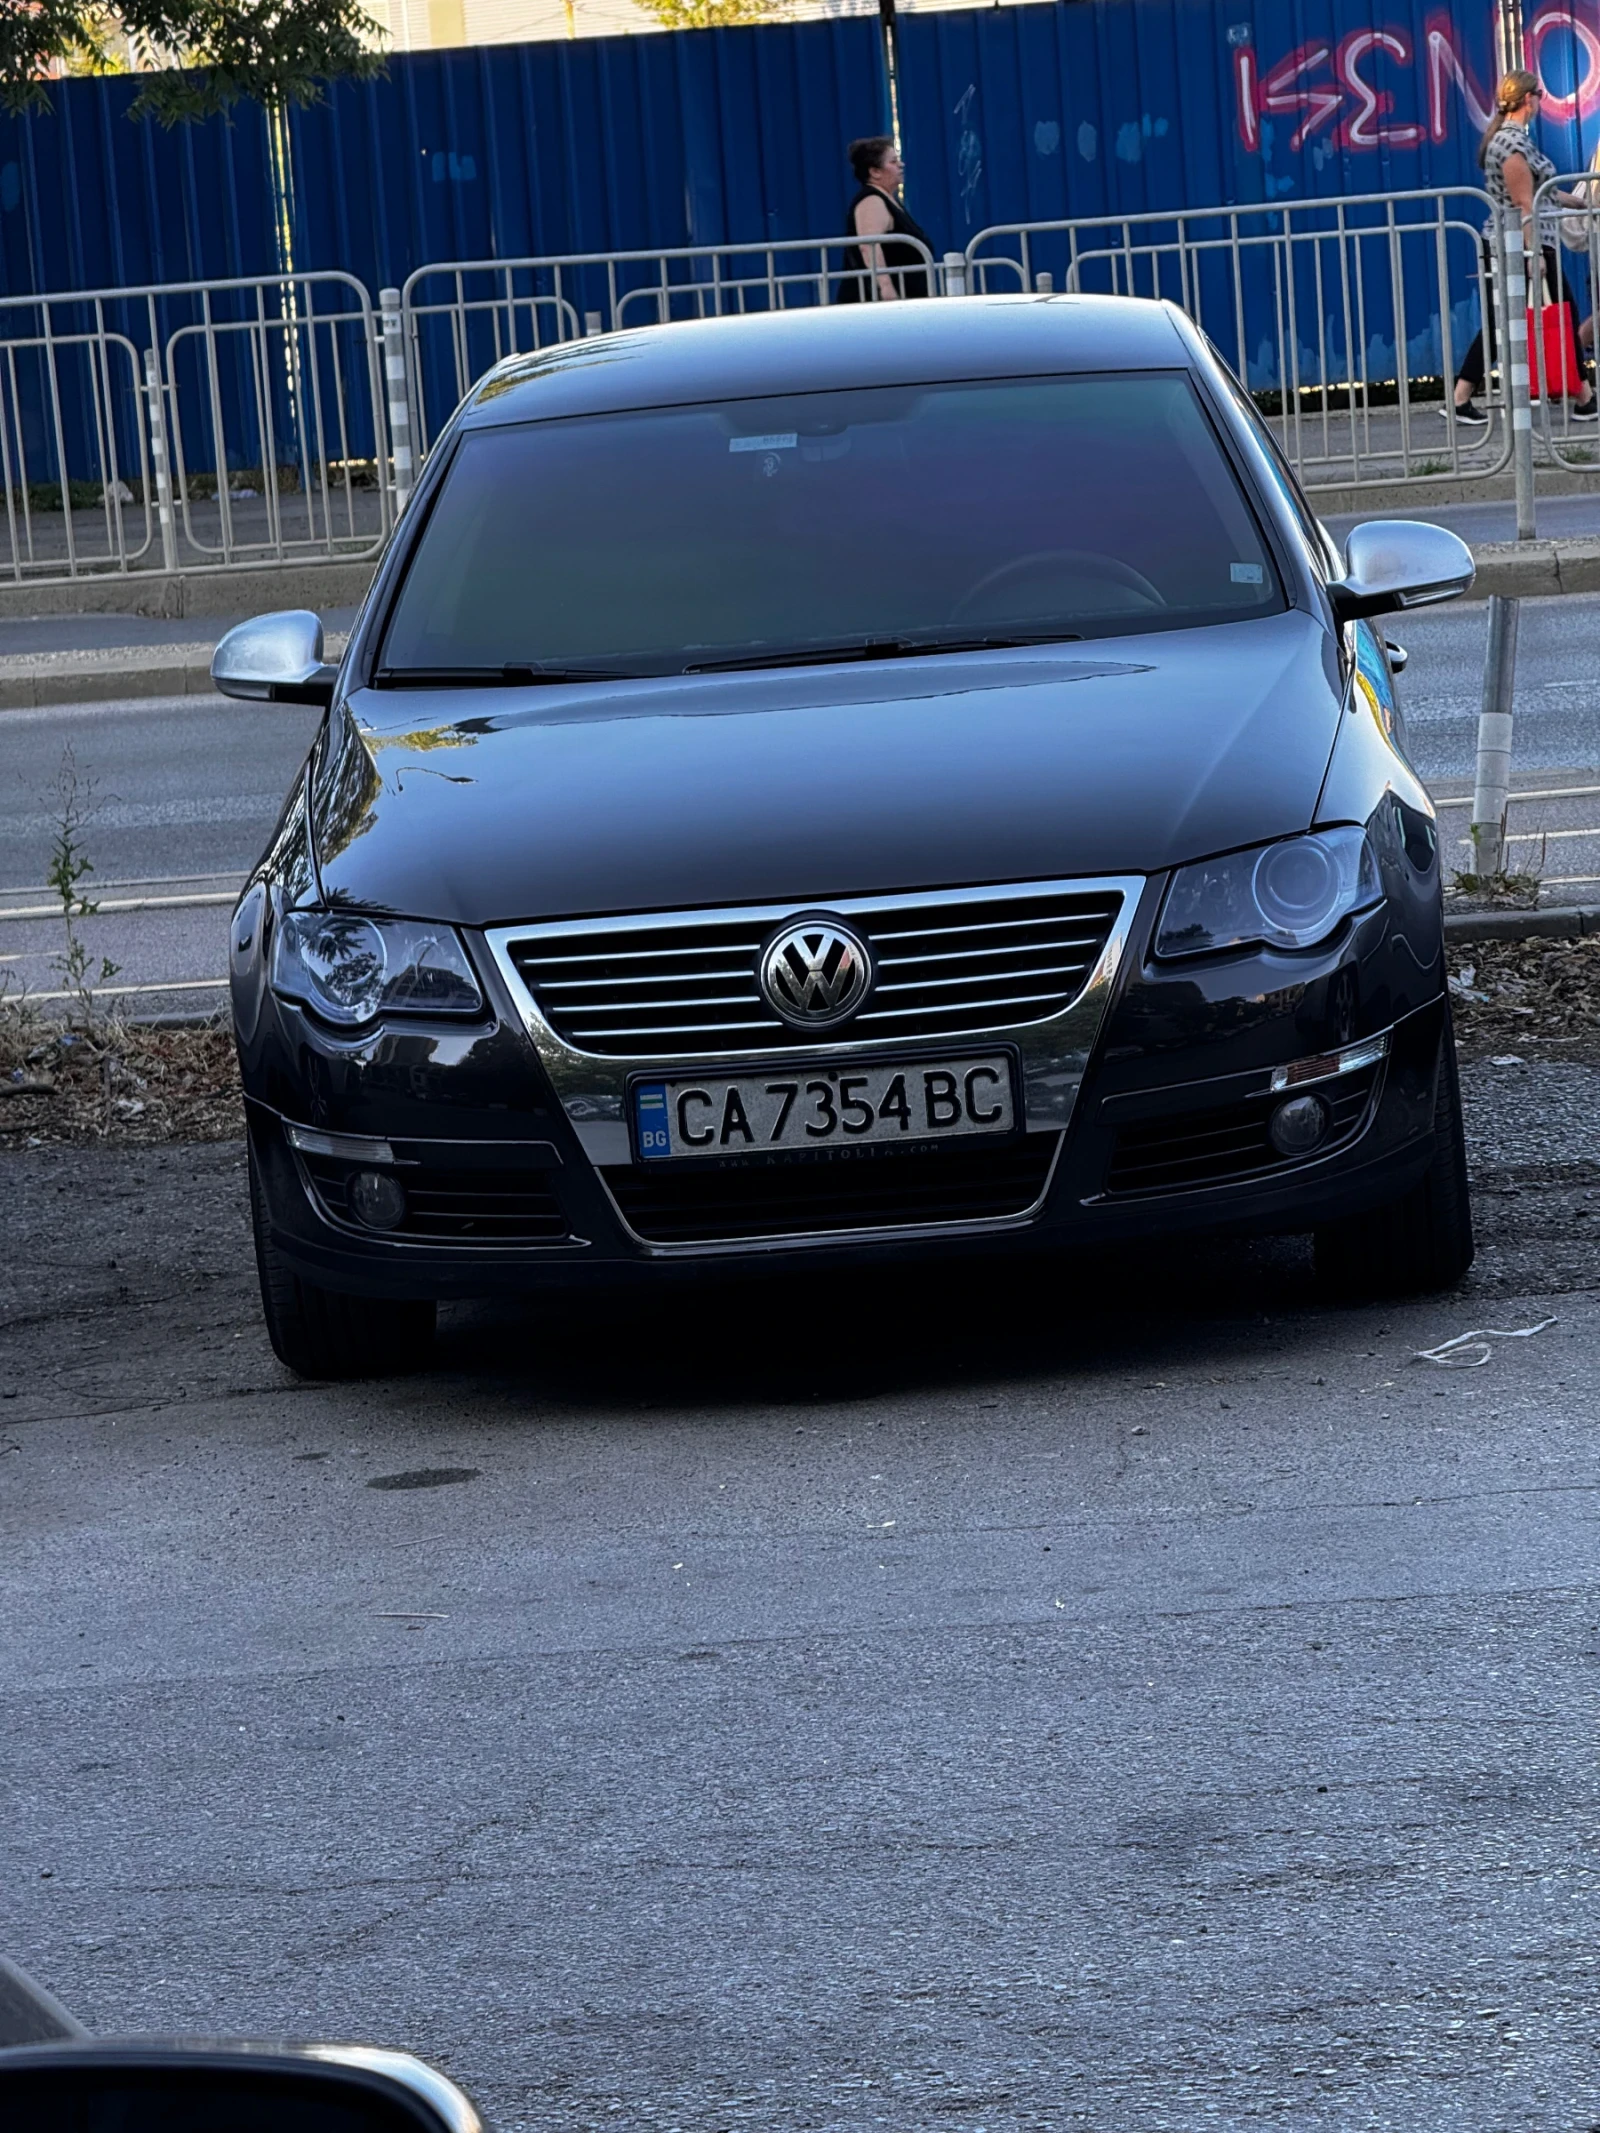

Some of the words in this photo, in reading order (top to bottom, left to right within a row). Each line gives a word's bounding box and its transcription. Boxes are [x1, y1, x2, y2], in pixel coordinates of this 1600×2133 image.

[676, 1086, 755, 1147] CA
[764, 1072, 912, 1141] 7354
[922, 1065, 1003, 1129] BC
[642, 1130, 667, 1148] BG
